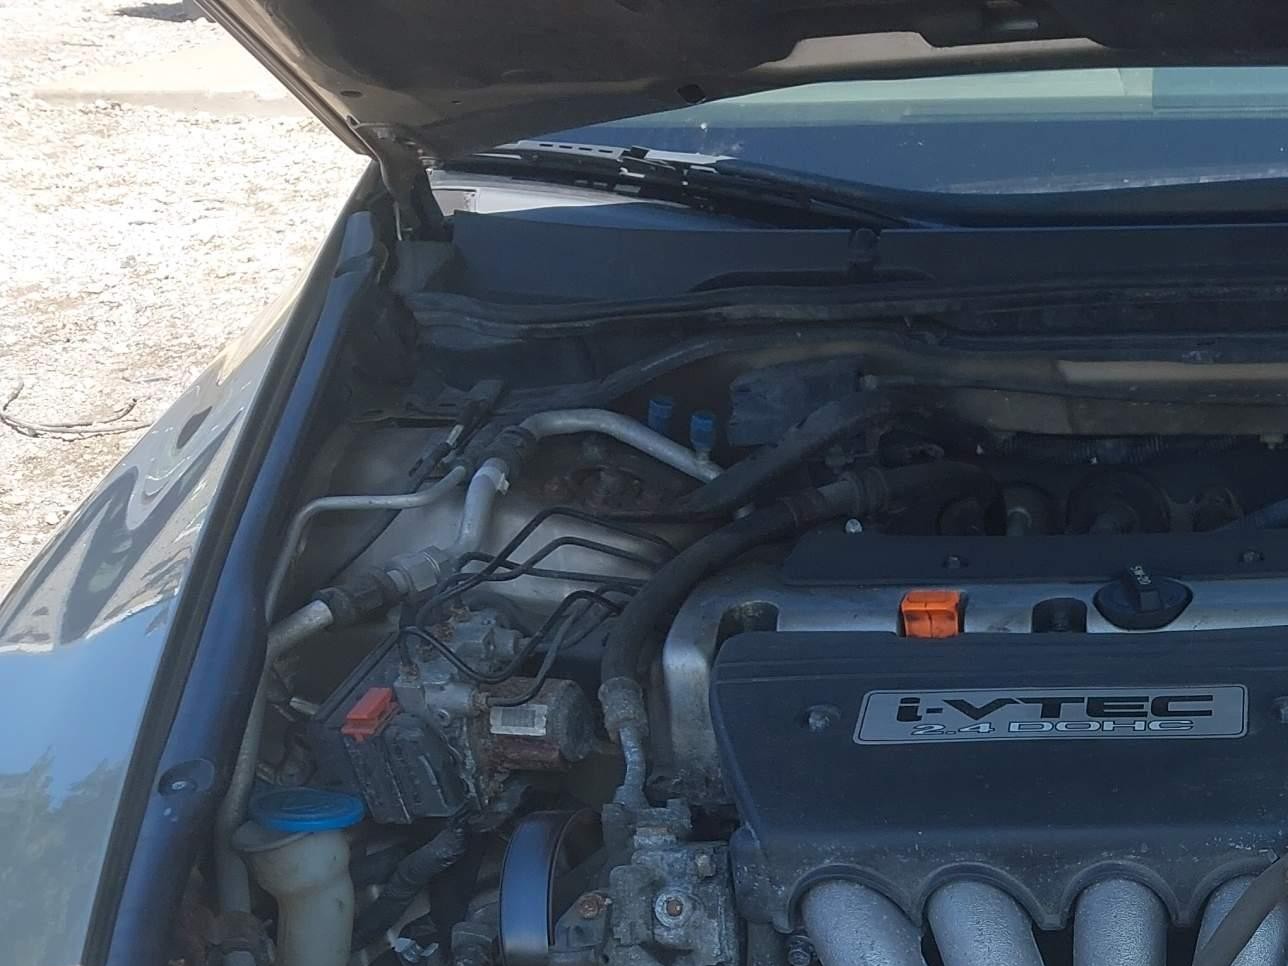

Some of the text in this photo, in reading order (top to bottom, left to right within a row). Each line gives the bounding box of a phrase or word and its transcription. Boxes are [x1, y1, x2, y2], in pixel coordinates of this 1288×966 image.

[896, 694, 1213, 723] i-VTEC
[910, 718, 1195, 736] 2.4 DOHC
